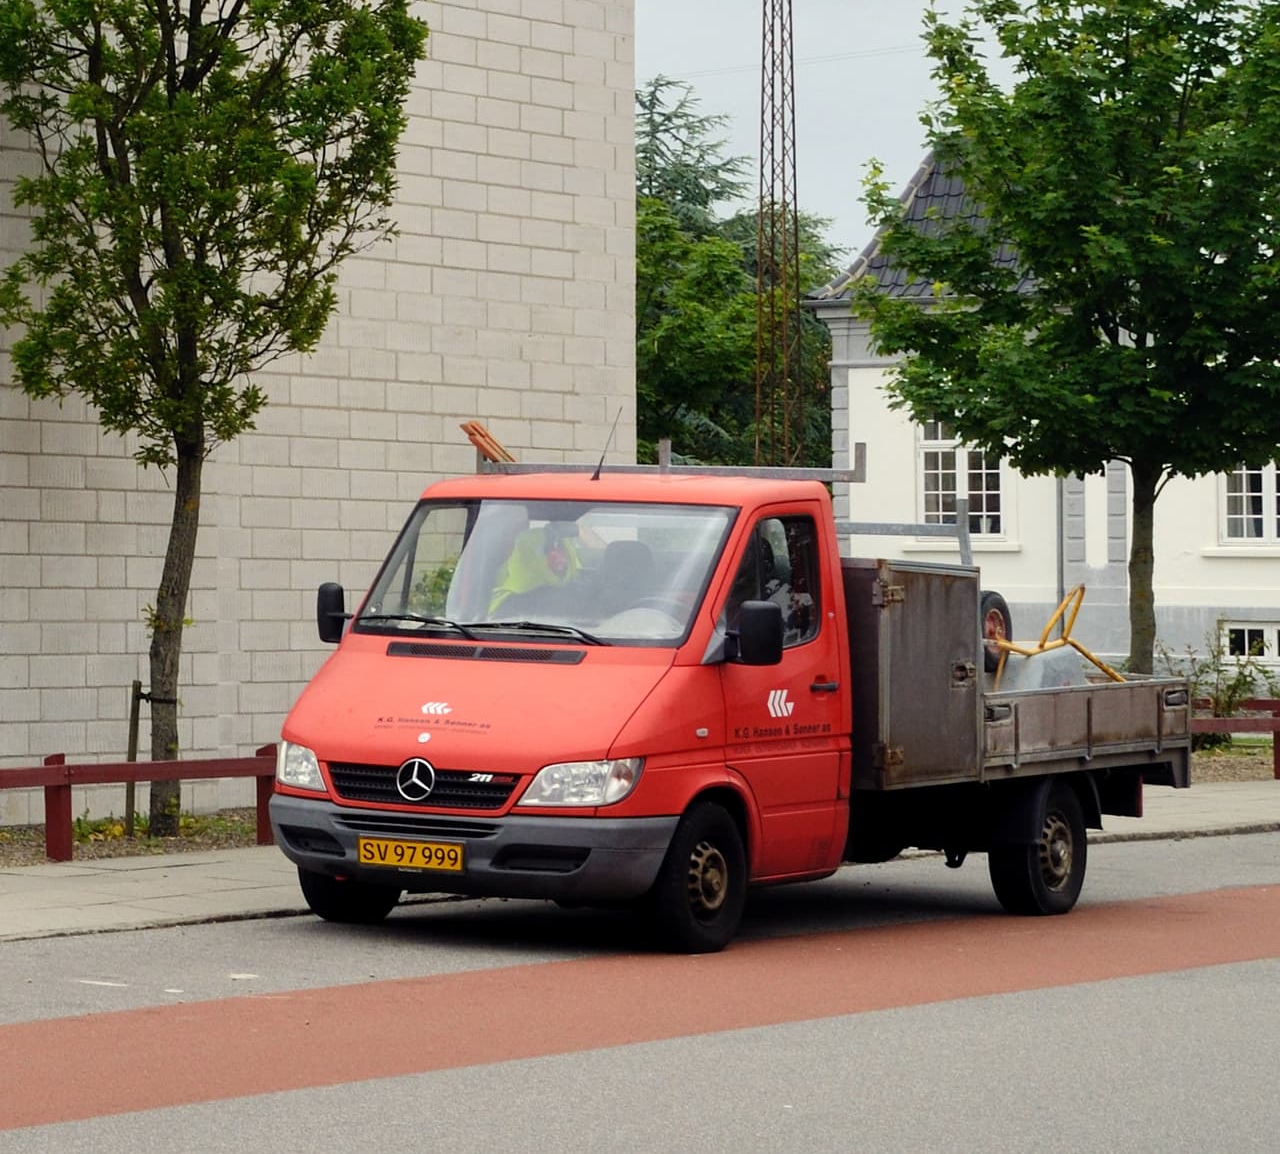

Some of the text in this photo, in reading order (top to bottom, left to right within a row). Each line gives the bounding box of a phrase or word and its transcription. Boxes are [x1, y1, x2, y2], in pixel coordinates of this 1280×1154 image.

[468, 773, 493, 782] 211
[363, 843, 459, 866] SV 97 999
